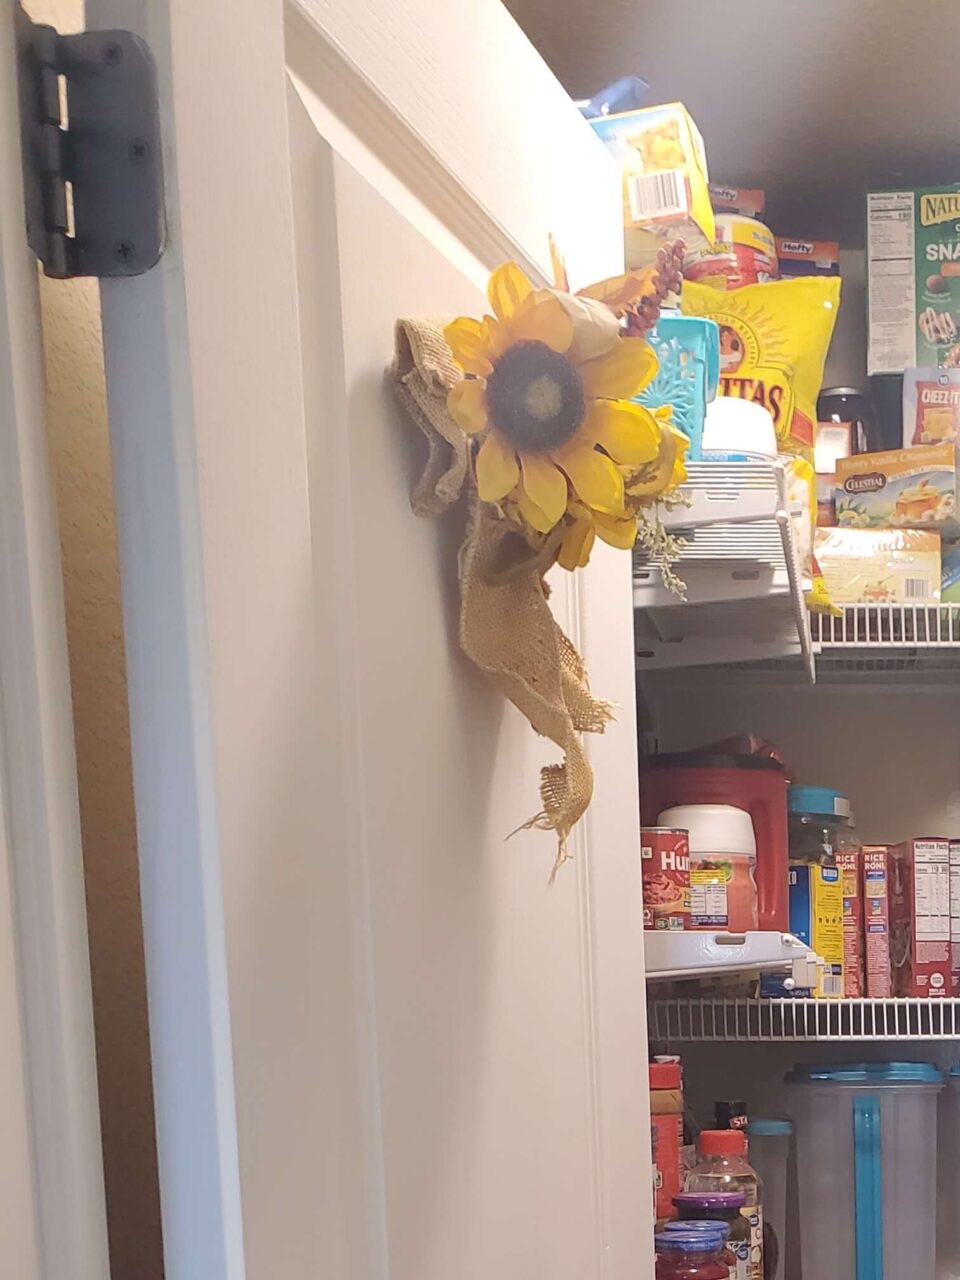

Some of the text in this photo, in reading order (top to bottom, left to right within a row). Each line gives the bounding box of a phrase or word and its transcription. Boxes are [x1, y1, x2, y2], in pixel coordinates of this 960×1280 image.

[783, 242, 812, 254] Hefty
[845, 478, 884, 491] CELESTIAL
[836, 854, 855, 862] RICE
[864, 854, 884, 862] RICE
[864, 862, 885, 870] RONI
